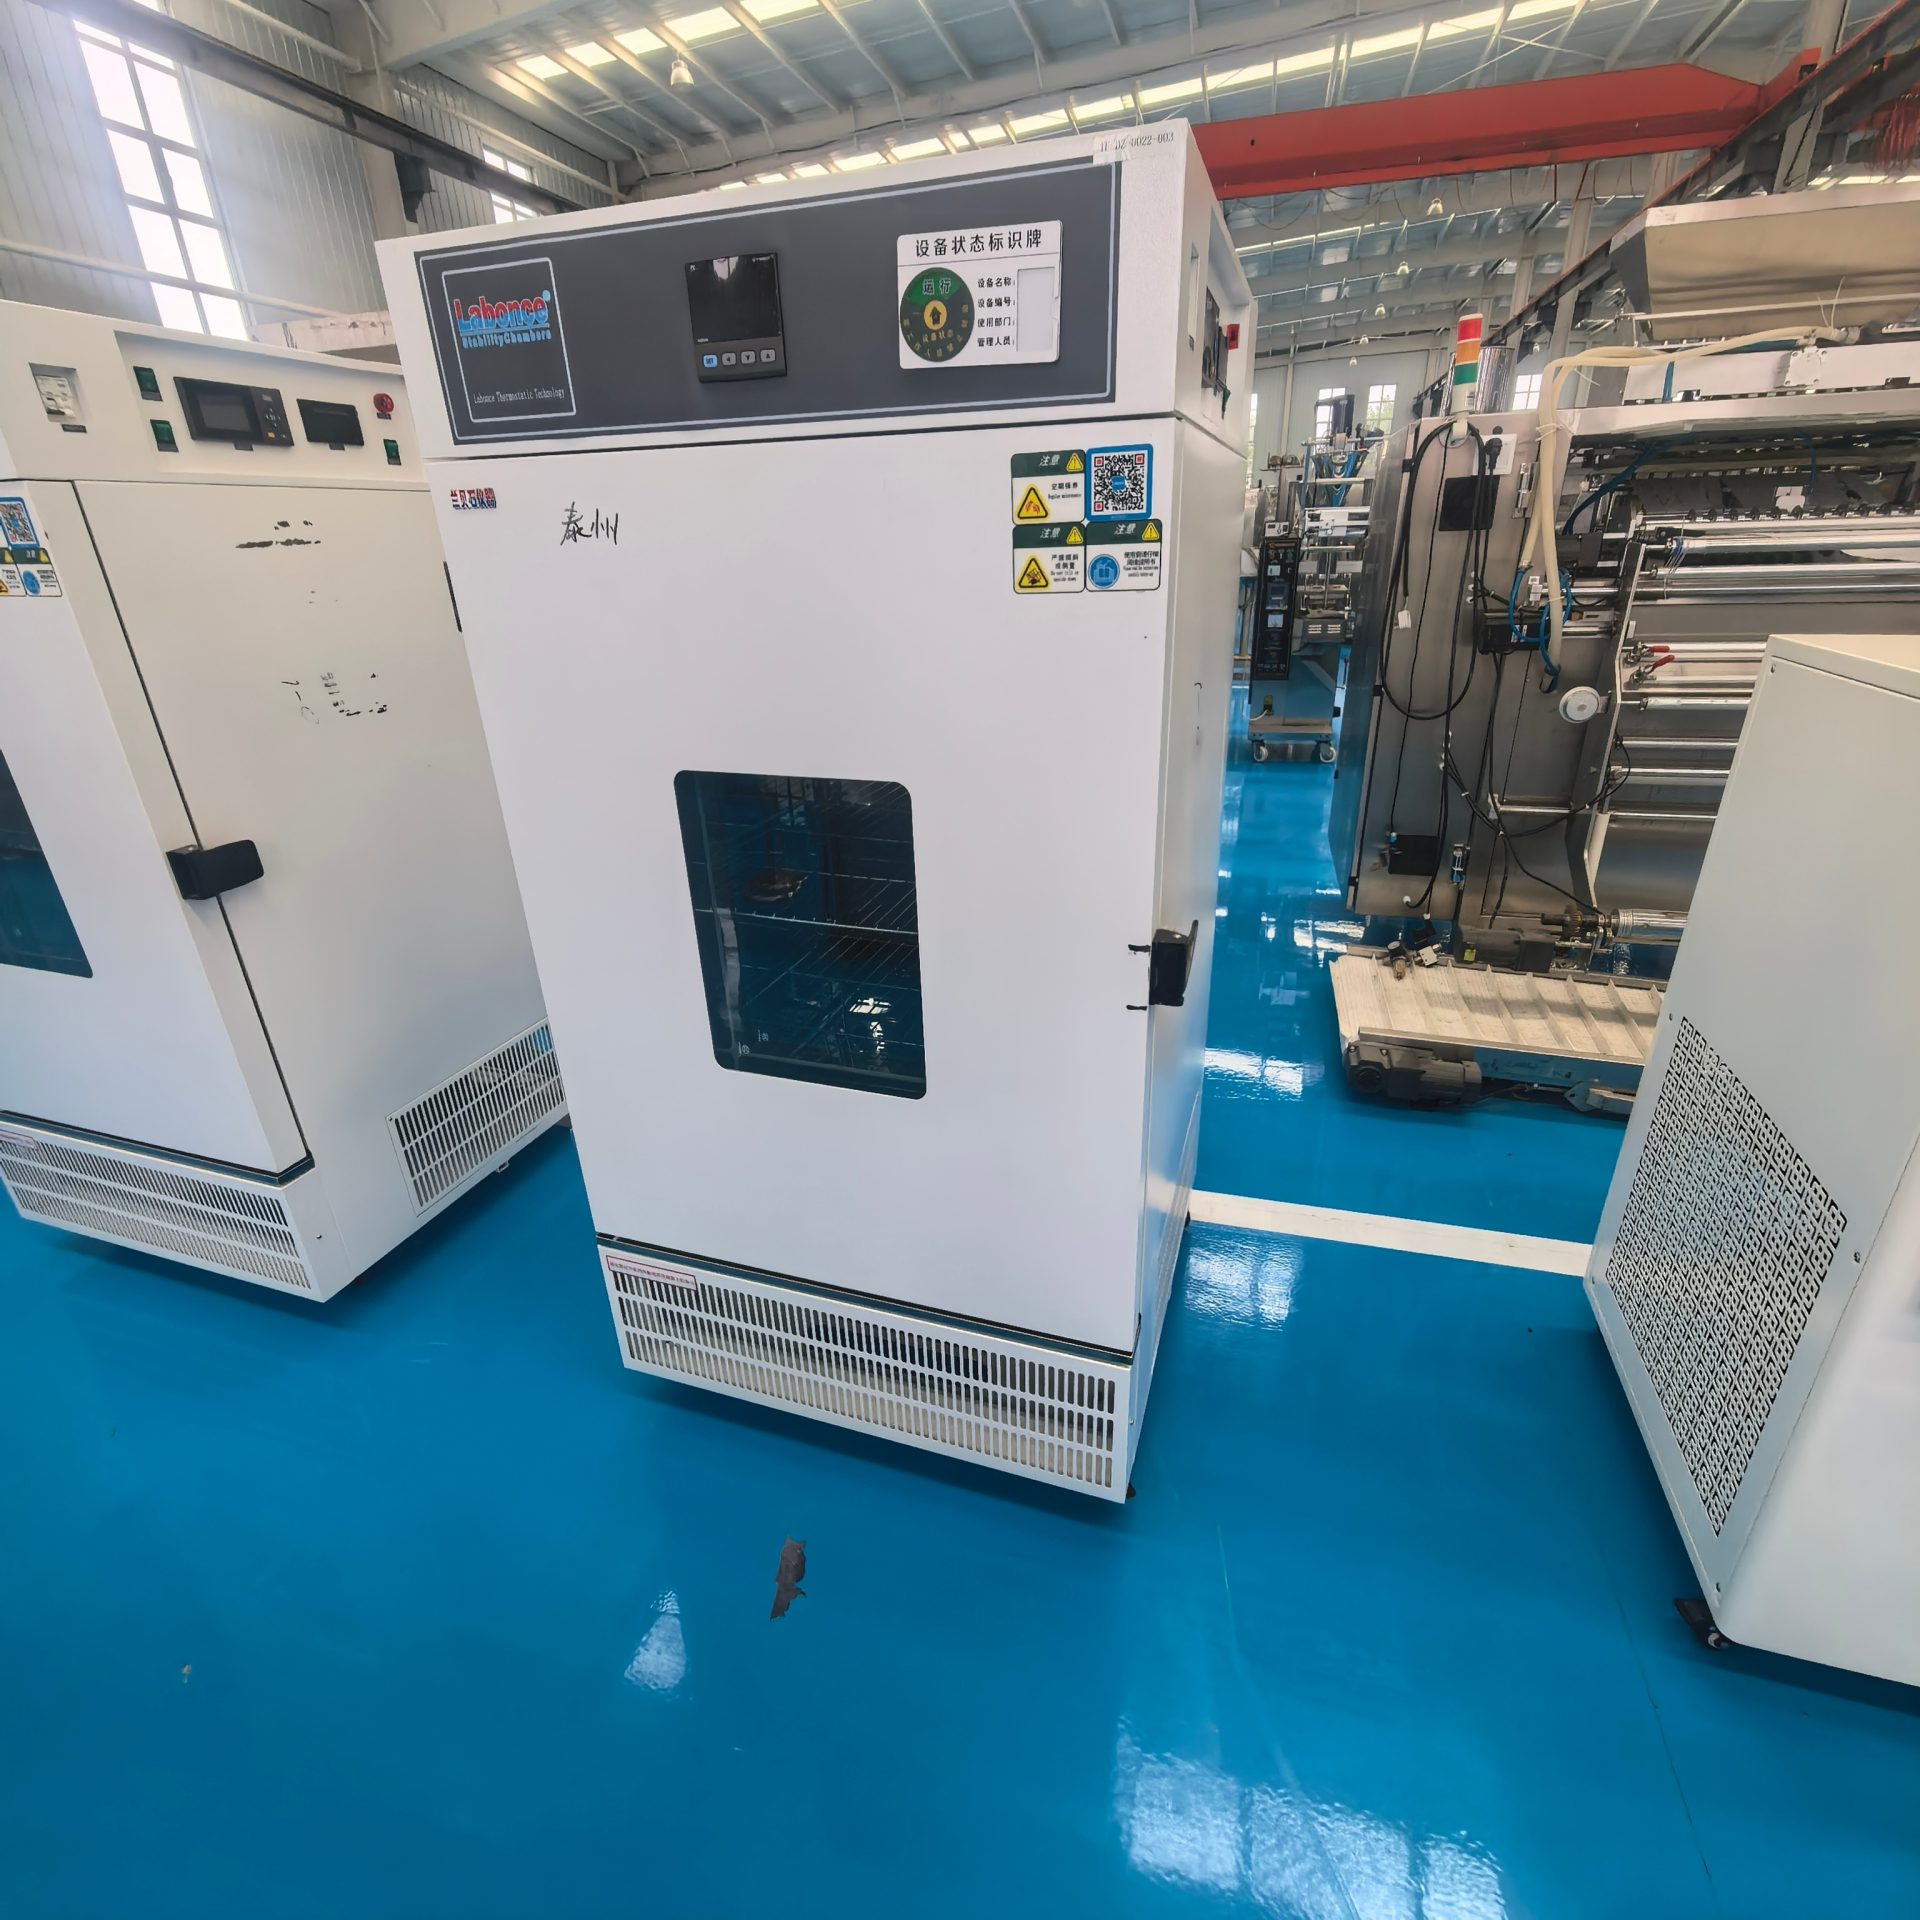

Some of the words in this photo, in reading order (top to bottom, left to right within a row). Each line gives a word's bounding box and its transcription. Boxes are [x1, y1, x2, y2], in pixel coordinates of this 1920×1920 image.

[915, 229, 1042, 257] 设备状态标识牌
[922, 278, 951, 295] 运行
[453, 296, 549, 332] Labonce
